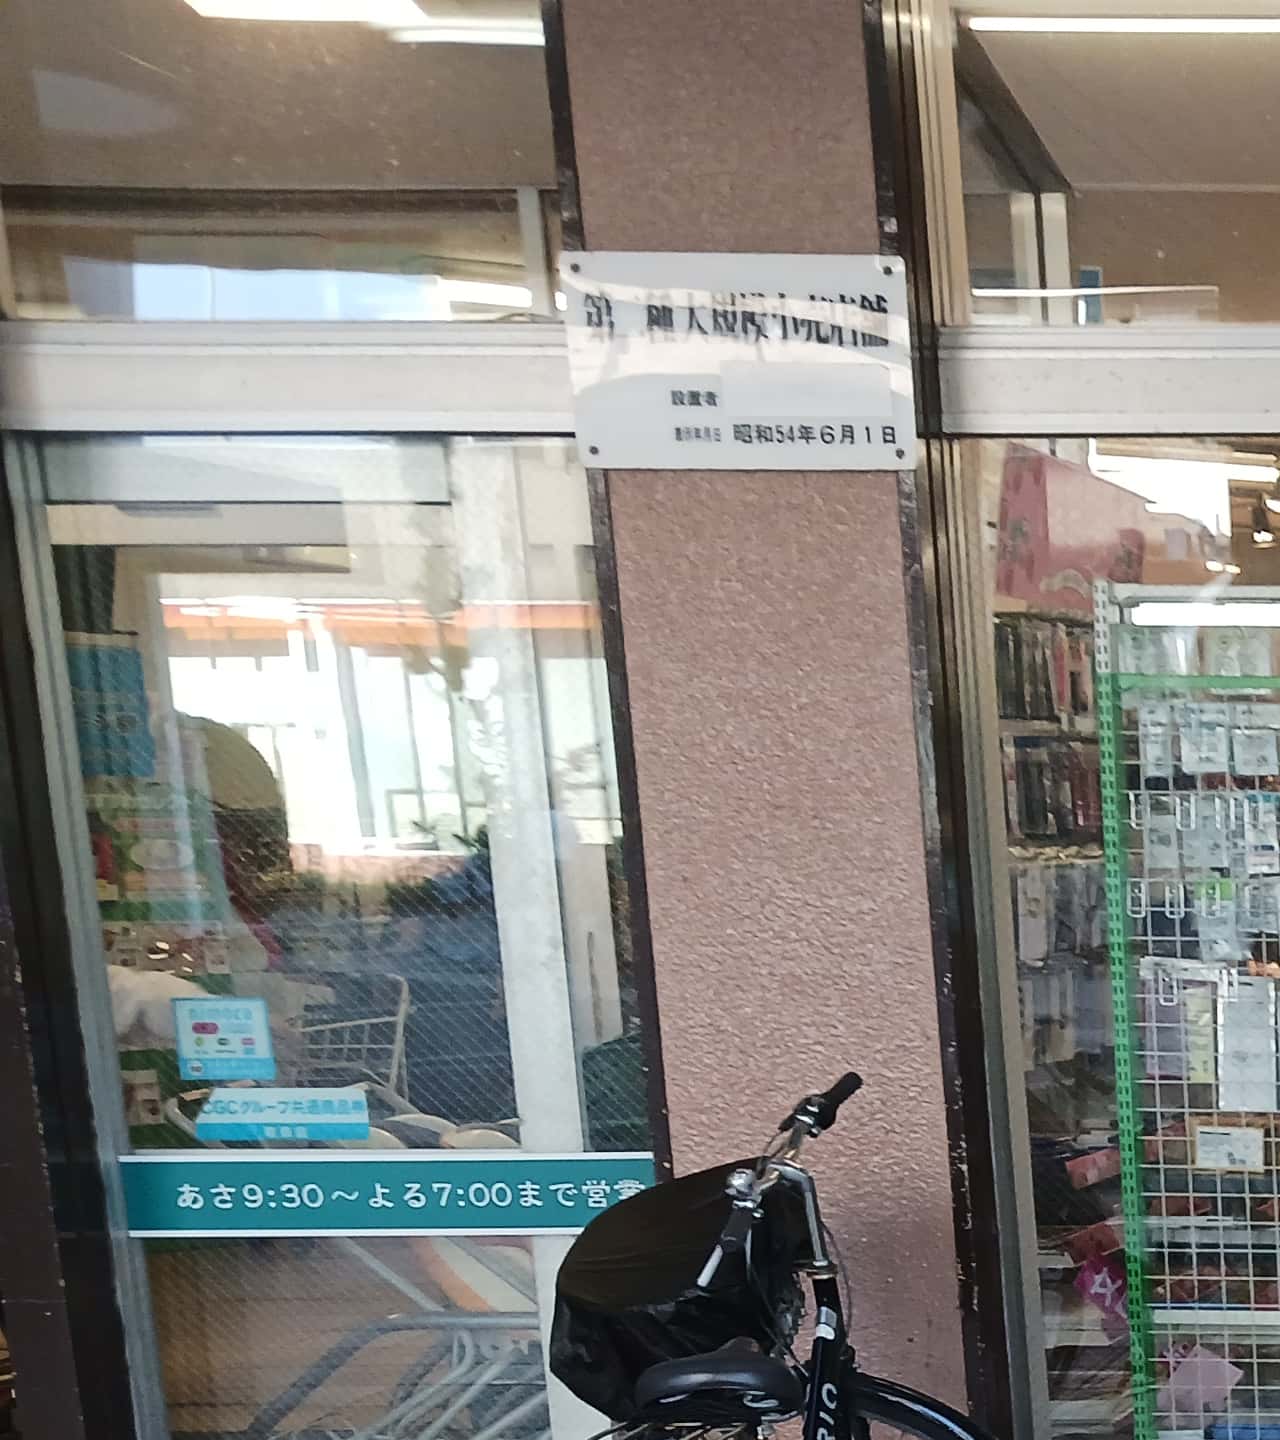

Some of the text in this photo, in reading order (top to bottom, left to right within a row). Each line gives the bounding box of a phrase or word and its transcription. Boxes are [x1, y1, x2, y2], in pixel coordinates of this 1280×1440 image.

[733, 424, 896, 444] 昭和54年6月1日
